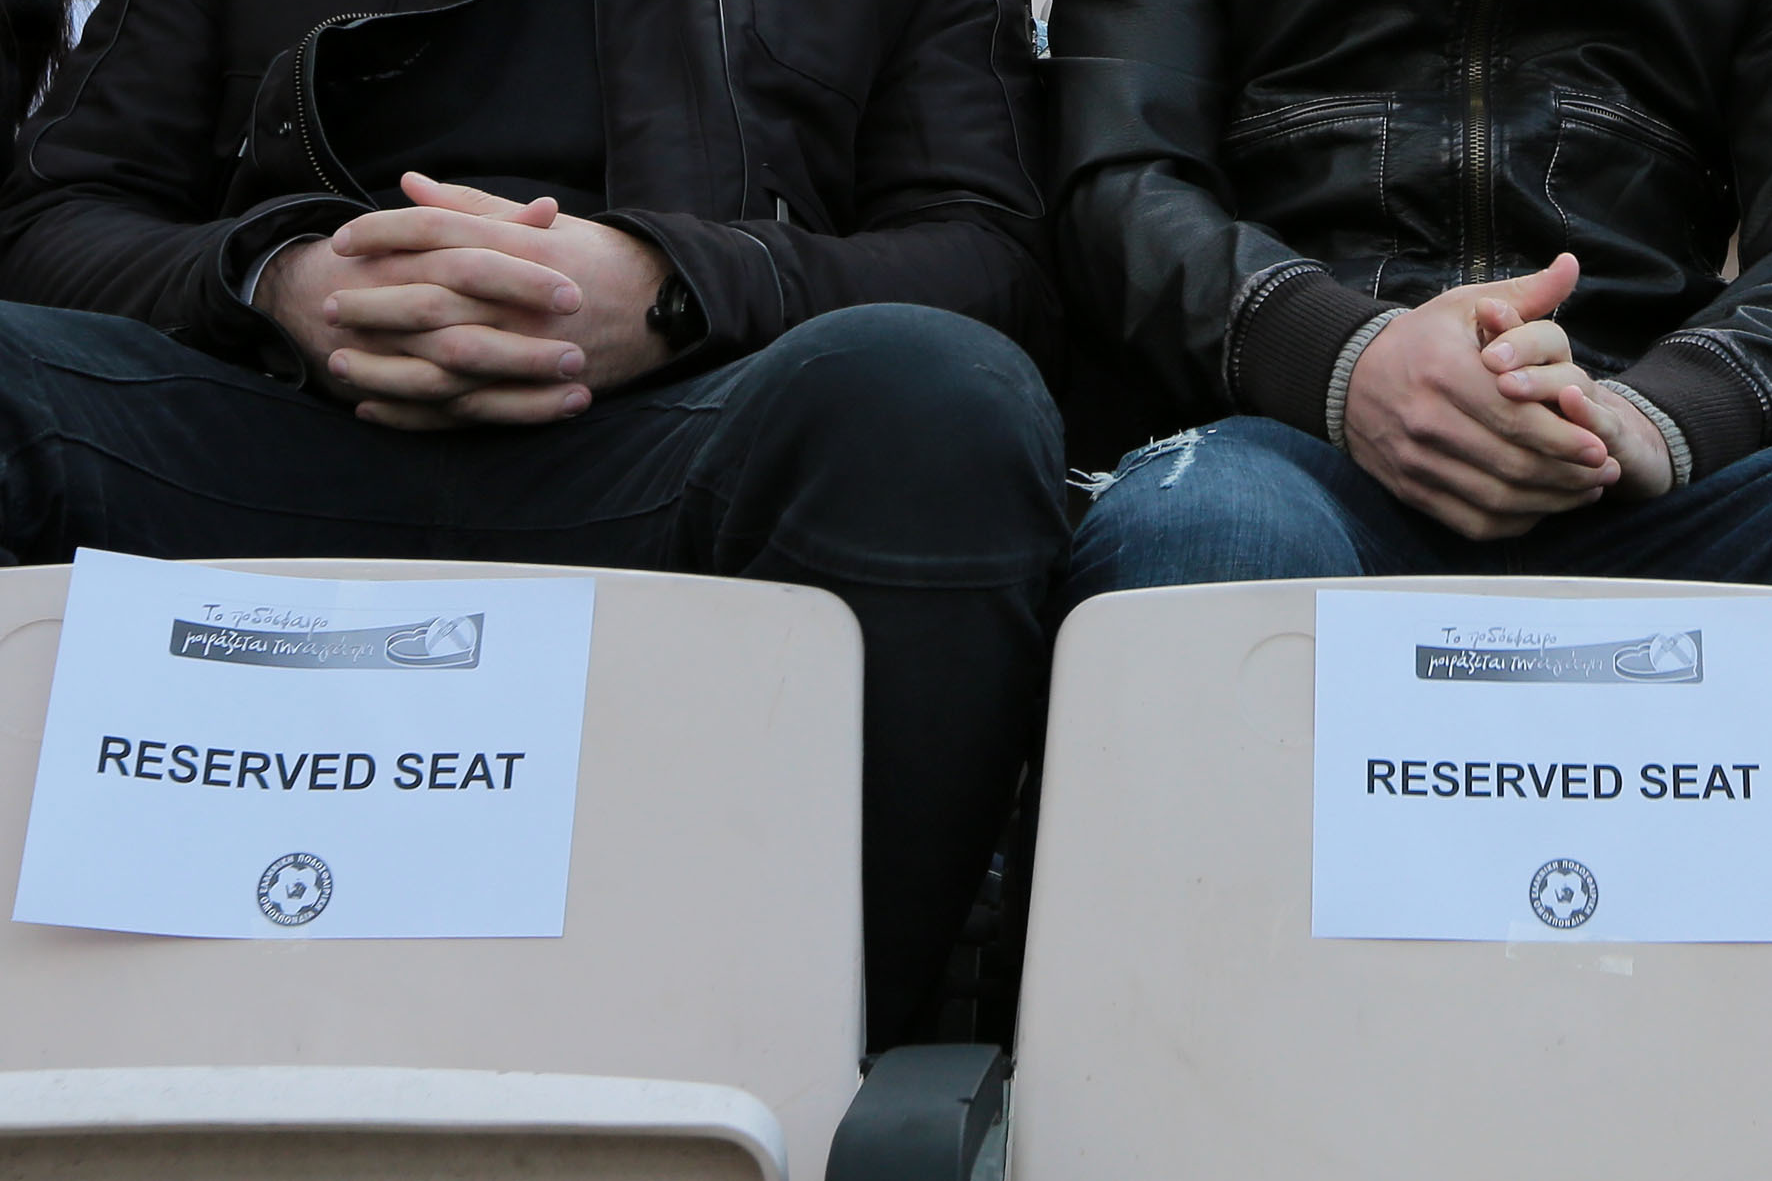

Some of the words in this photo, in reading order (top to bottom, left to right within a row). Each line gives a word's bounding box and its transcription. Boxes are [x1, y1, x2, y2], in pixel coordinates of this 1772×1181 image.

[202, 603, 224, 621] Το
[182, 628, 268, 657] μοιράζεται
[271, 638, 302, 656] την
[1441, 627, 1461, 644] Το
[1428, 651, 1506, 678] μοιράζεται
[1510, 656, 1537, 672] την
[97, 735, 377, 790] RESERVED
[393, 752, 526, 790] SEAT
[1367, 759, 1623, 799] RESERVED
[1640, 763, 1760, 799] SEAT
